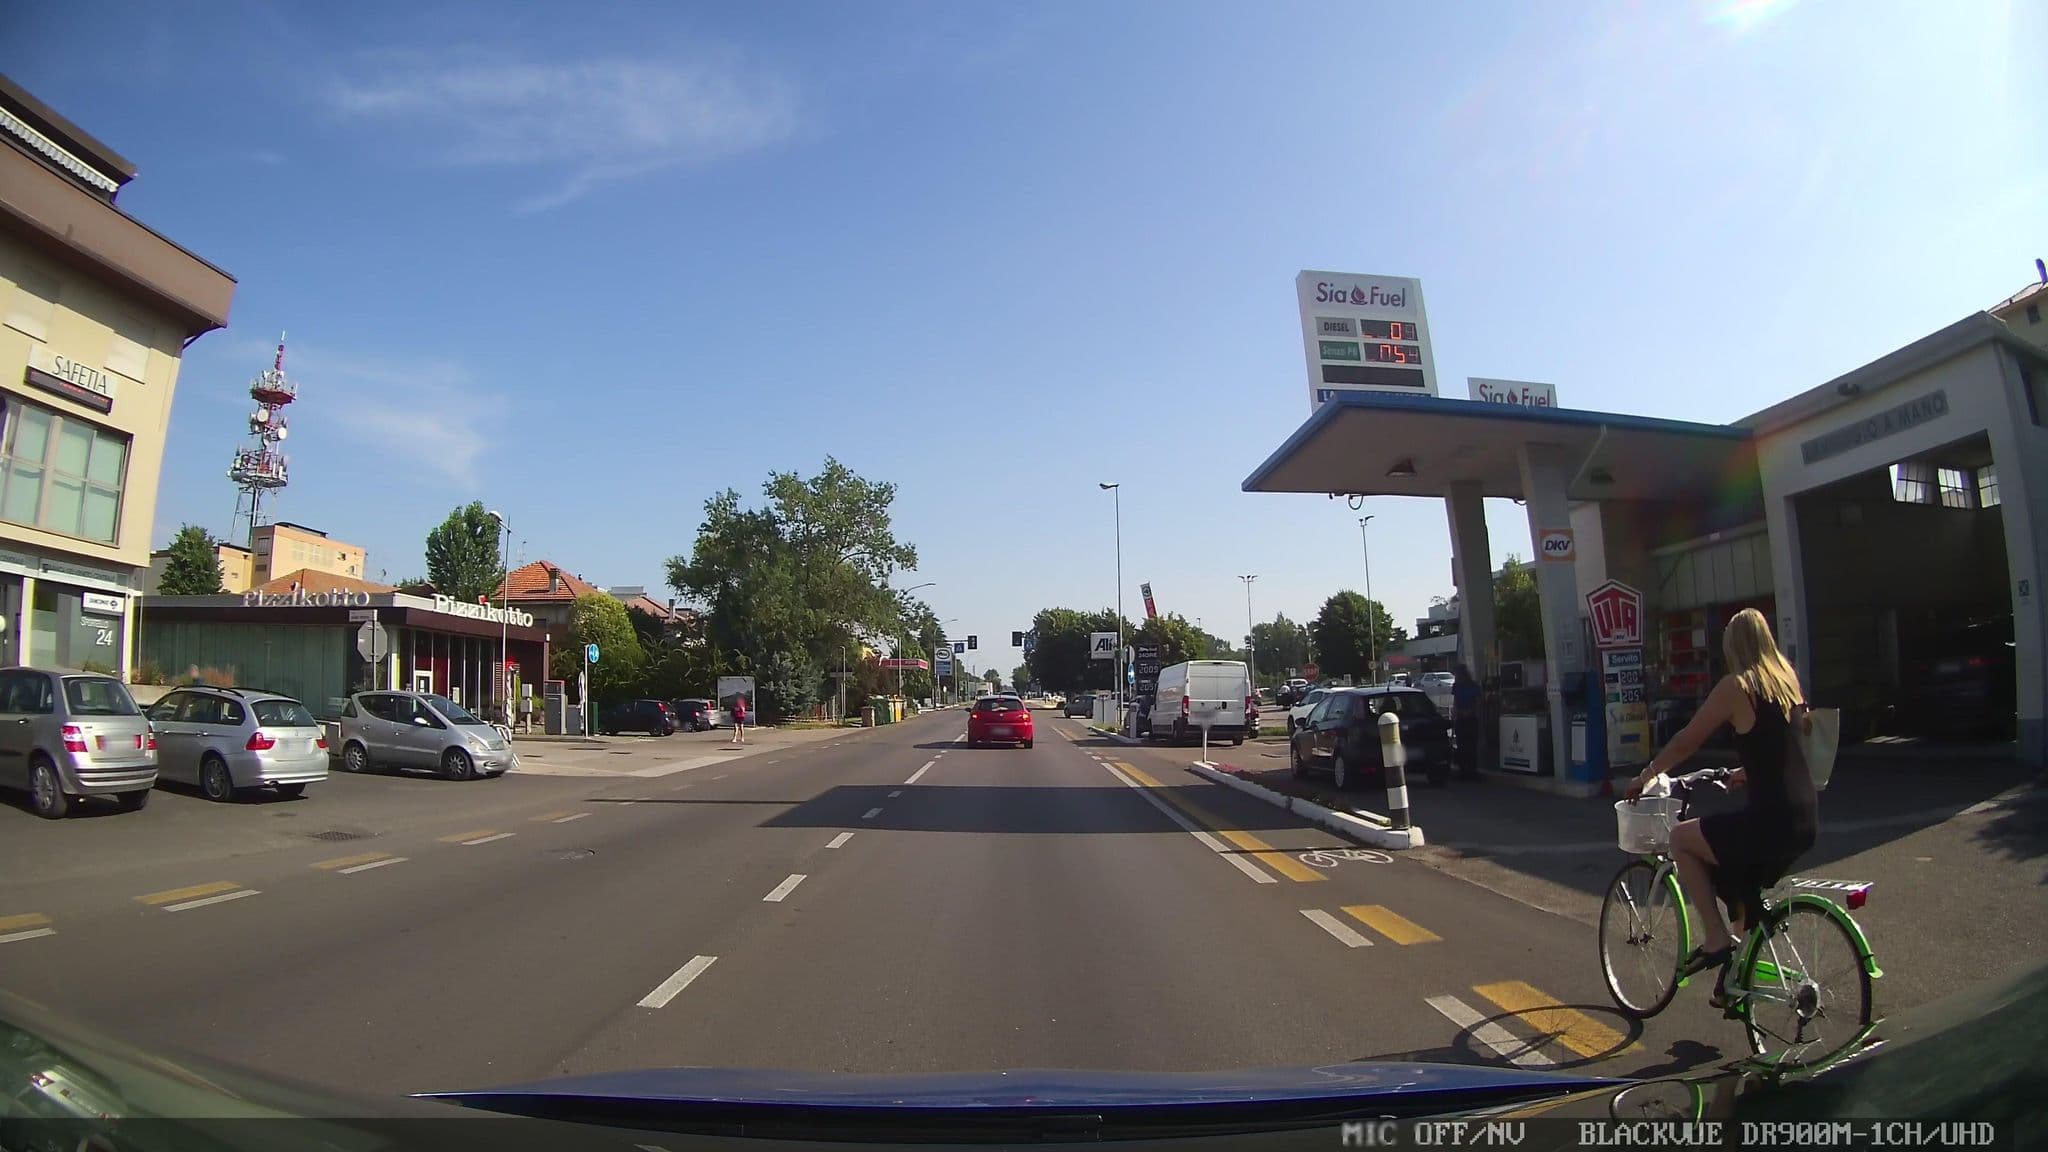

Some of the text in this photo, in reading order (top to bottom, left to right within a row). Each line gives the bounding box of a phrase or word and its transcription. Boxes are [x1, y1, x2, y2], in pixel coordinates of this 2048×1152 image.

[1316, 282, 1406, 307] Sia Fuel
[1324, 322, 1350, 332] DIESEL
[1544, 540, 1570, 551] DKV
[242, 582, 370, 607] Pizzikotto
[431, 593, 534, 627] Pizzikotto
[96, 629, 113, 646] 24
